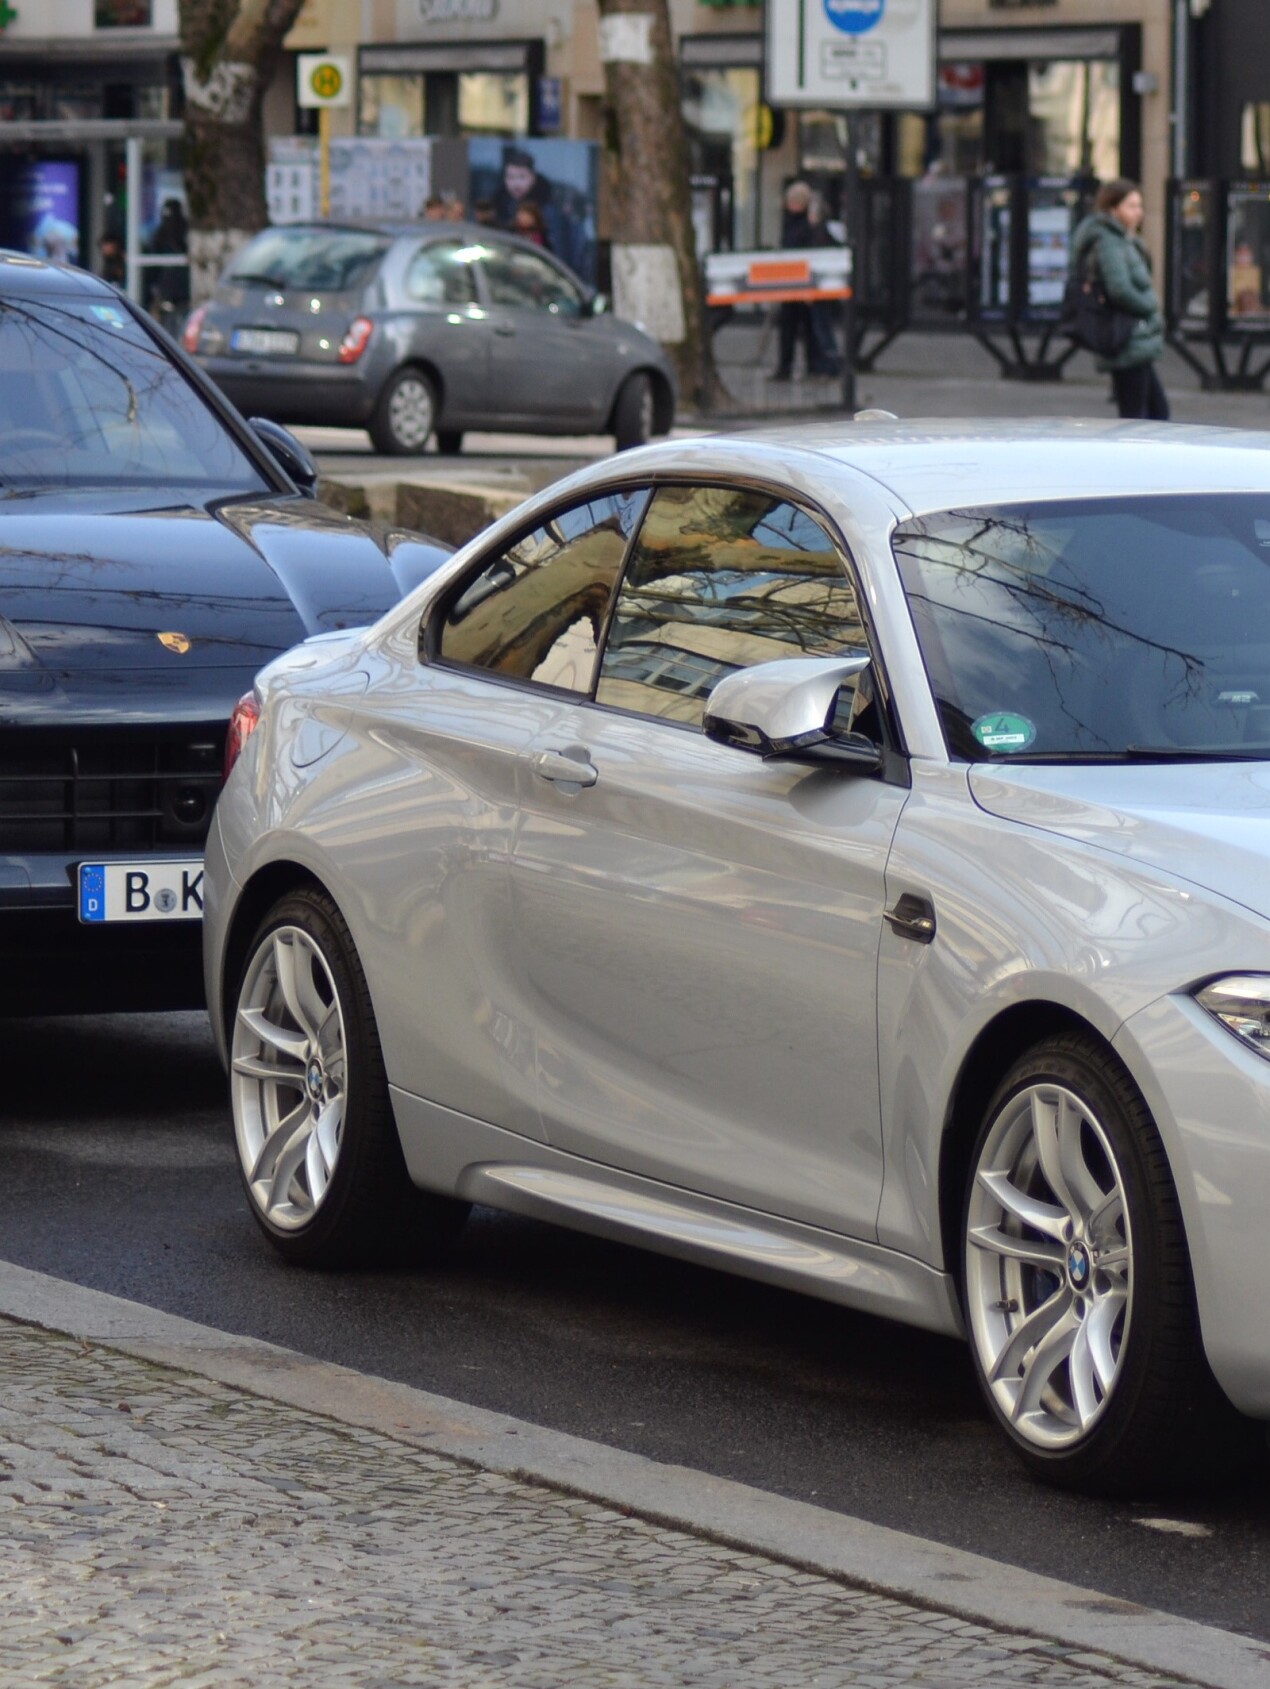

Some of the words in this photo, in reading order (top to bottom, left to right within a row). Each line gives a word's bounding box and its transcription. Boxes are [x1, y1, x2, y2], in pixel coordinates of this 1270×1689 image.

[995, 718, 1010, 733] 4
[126, 872, 150, 912] B
[182, 870, 204, 911] K
[88, 899, 98, 911] D
